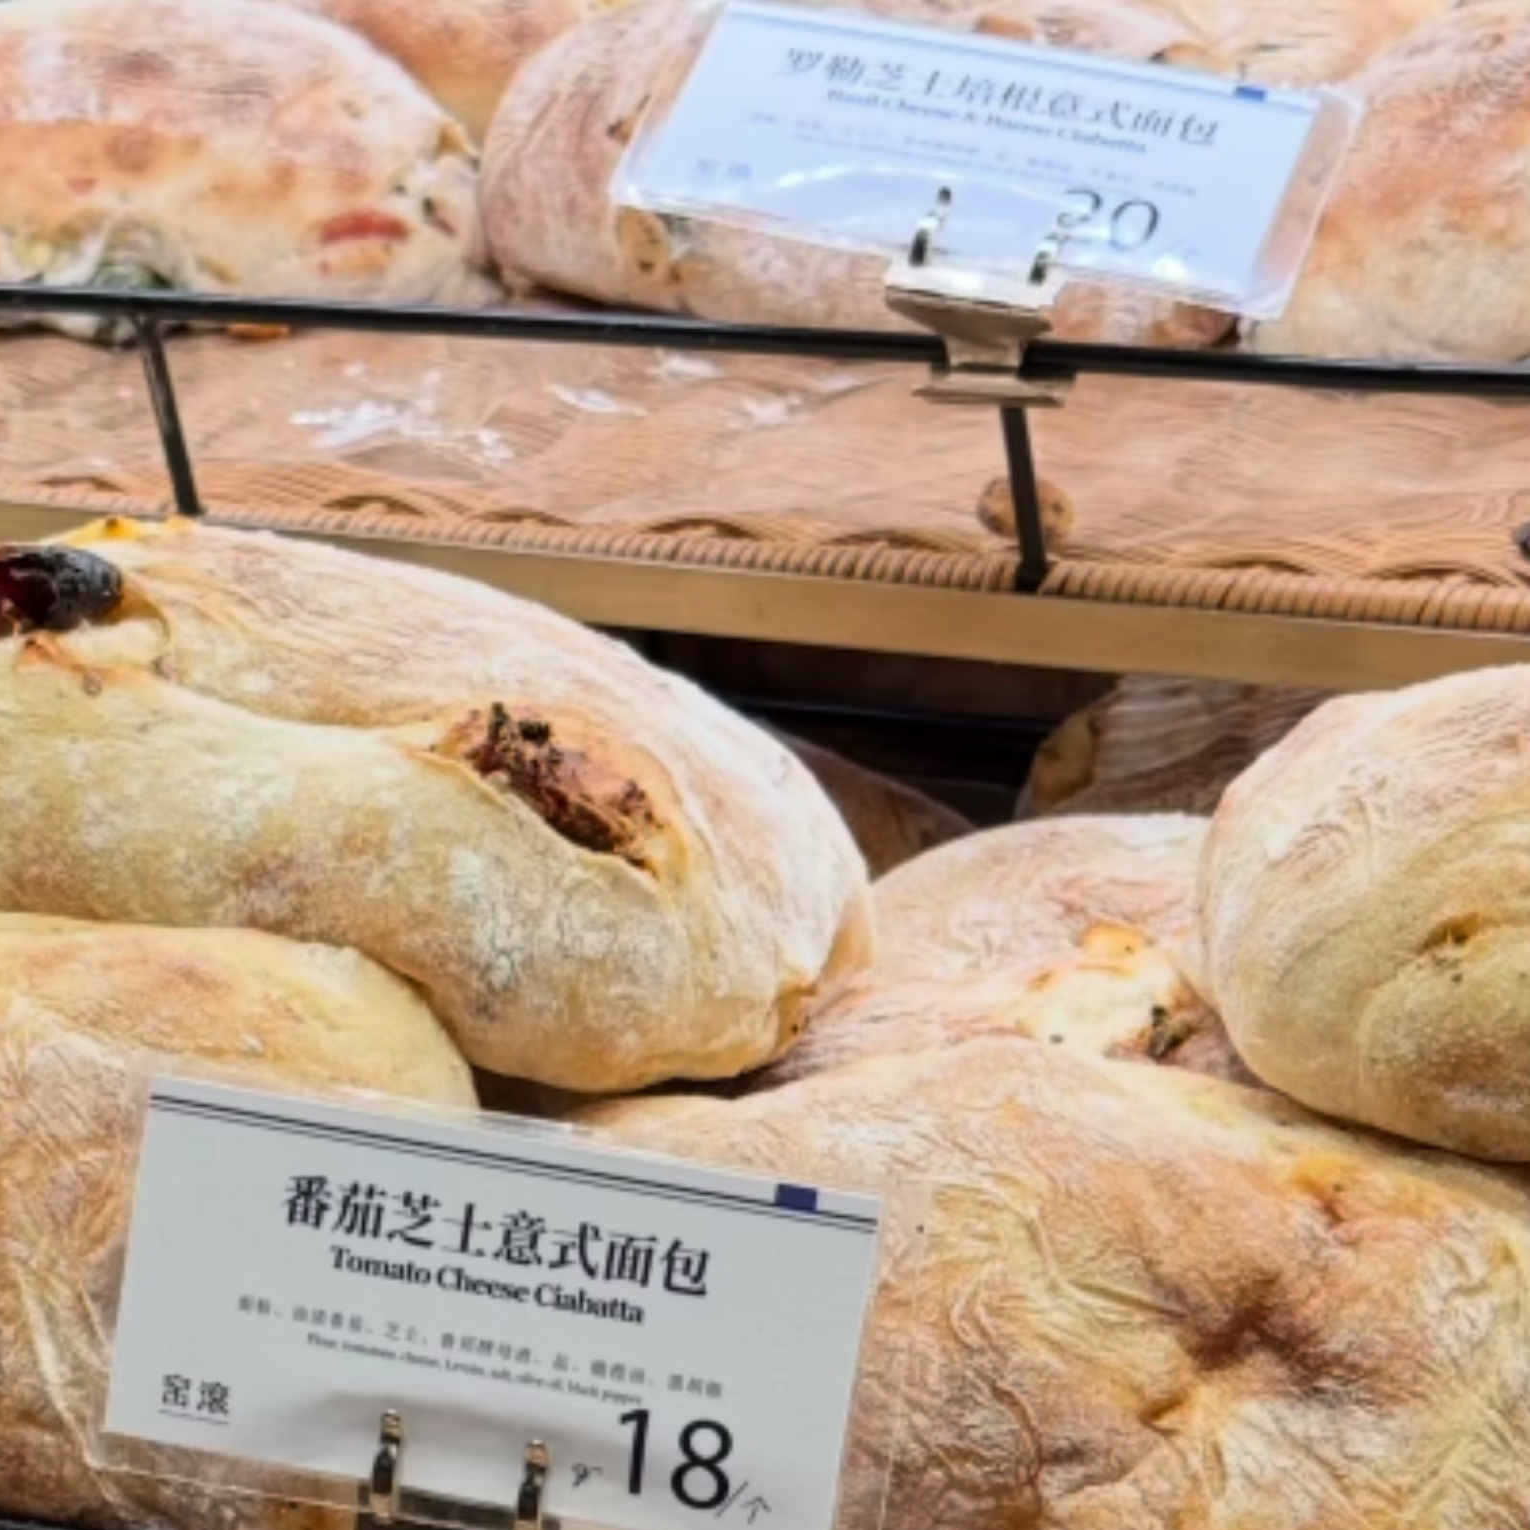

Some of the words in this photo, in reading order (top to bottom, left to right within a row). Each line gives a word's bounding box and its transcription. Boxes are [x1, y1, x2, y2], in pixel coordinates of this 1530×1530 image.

[282, 1175, 709, 1297] 番茄芝士意式面包
[330, 1245, 431, 1285] Tomato
[436, 1264, 530, 1303] Cheese
[533, 1282, 646, 1324] Ciabatta
